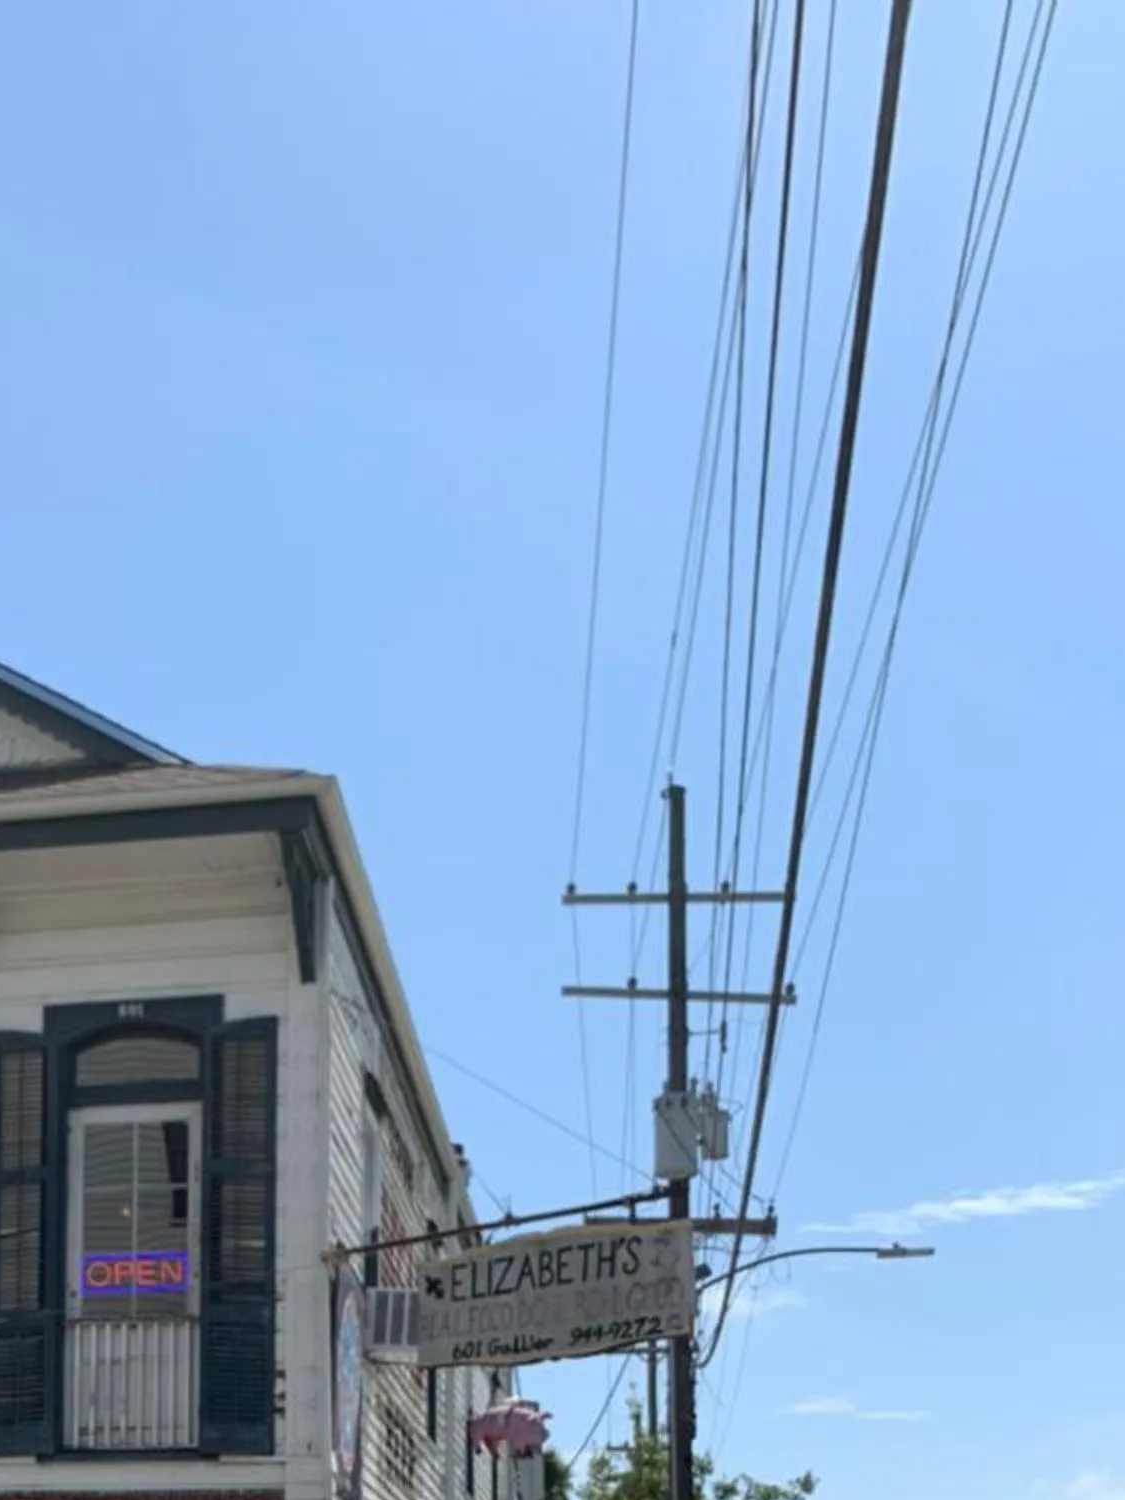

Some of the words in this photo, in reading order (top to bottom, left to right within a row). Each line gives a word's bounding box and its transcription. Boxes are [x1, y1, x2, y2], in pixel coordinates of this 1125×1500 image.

[86, 1260, 183, 1287] OPEN
[451, 1235, 642, 1302] ELIZABETH'S
[452, 1342, 482, 1361] 601
[570, 1316, 663, 1347] 944-9272
